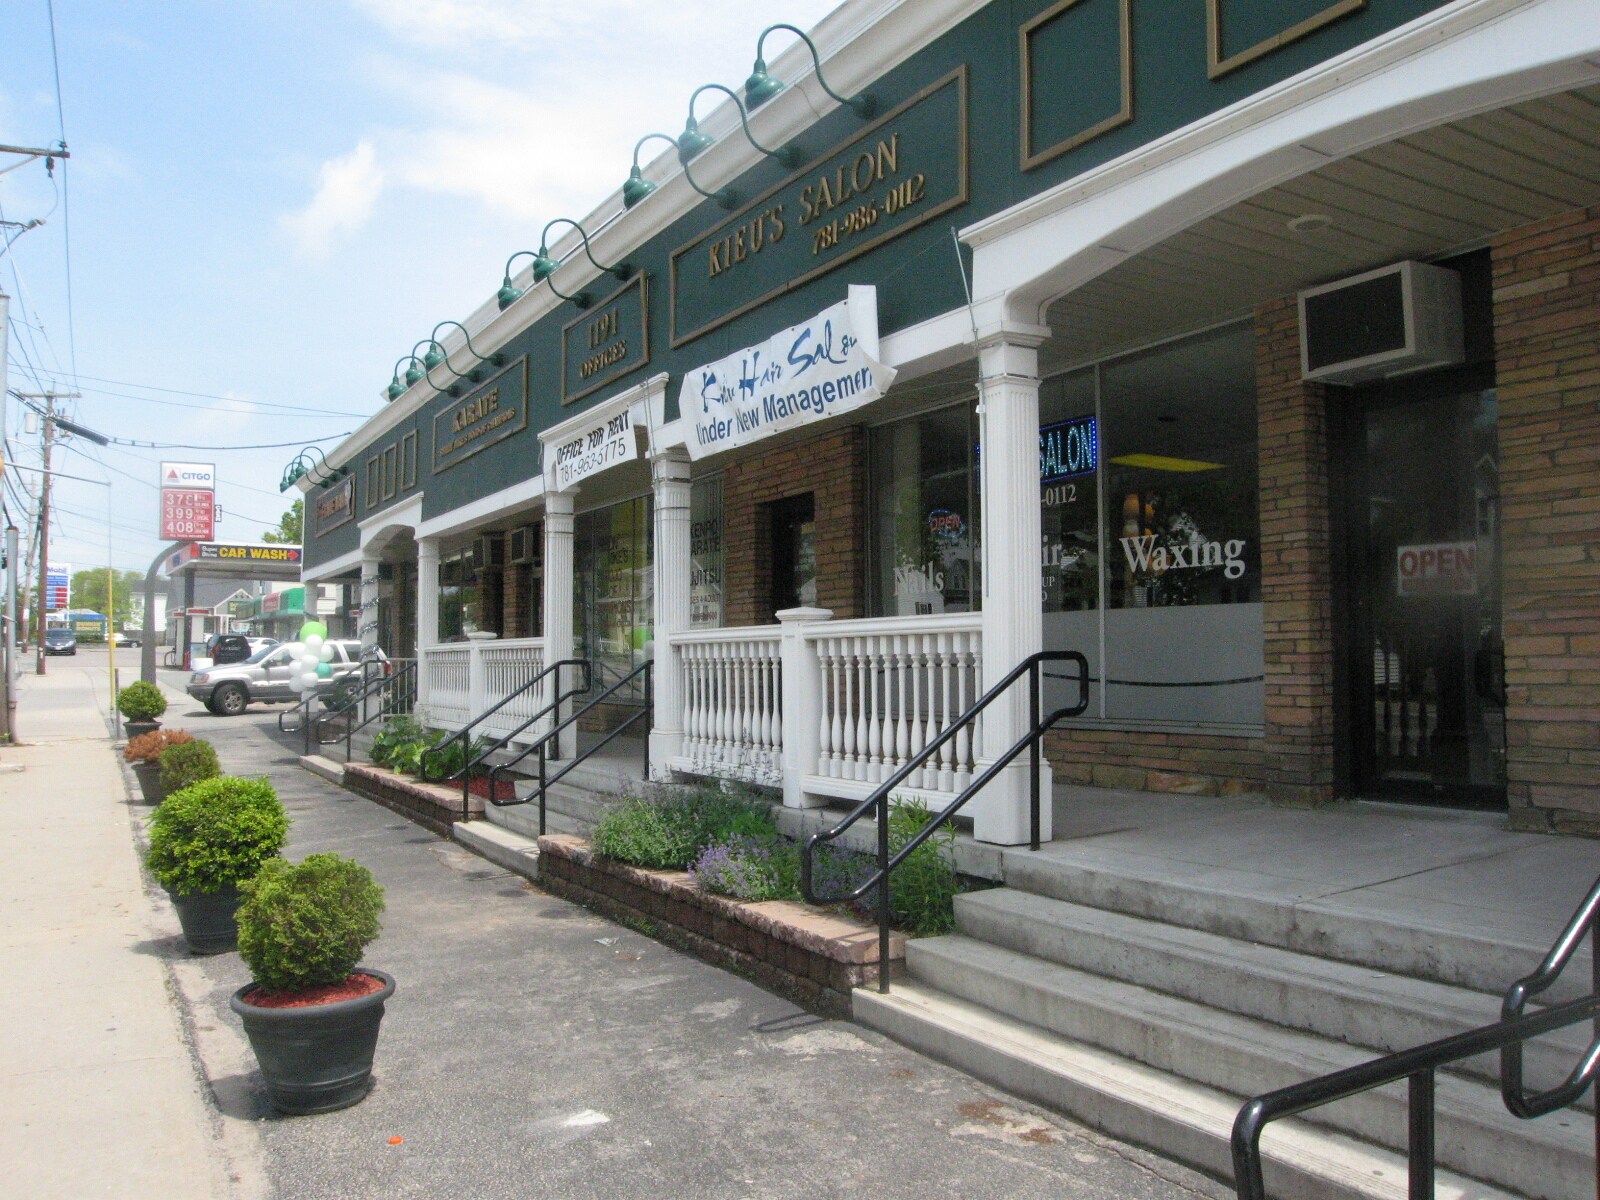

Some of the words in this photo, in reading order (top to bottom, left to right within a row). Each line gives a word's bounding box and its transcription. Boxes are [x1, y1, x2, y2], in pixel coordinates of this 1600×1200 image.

[709, 204, 784, 277] KIEU'S
[799, 133, 898, 225] SALON
[580, 340, 626, 378] OFFICES
[739, 351, 783, 401] Hair
[696, 414, 733, 446] Under
[736, 406, 760, 434] New
[763, 366, 873, 423] Managemen
[556, 438, 583, 466] OFFICE
[587, 427, 605, 451] FOR
[608, 409, 629, 439] RENT
[182, 472, 211, 480] CITGO
[560, 437, 626, 484] 781-963-5775
[929, 513, 960, 532] OPEN
[219, 547, 247, 558] CAR
[249, 549, 288, 560] WASH
[1119, 534, 1246, 579] Waxing
[1399, 546, 1475, 576] OPEN
[893, 561, 945, 595] Nails
